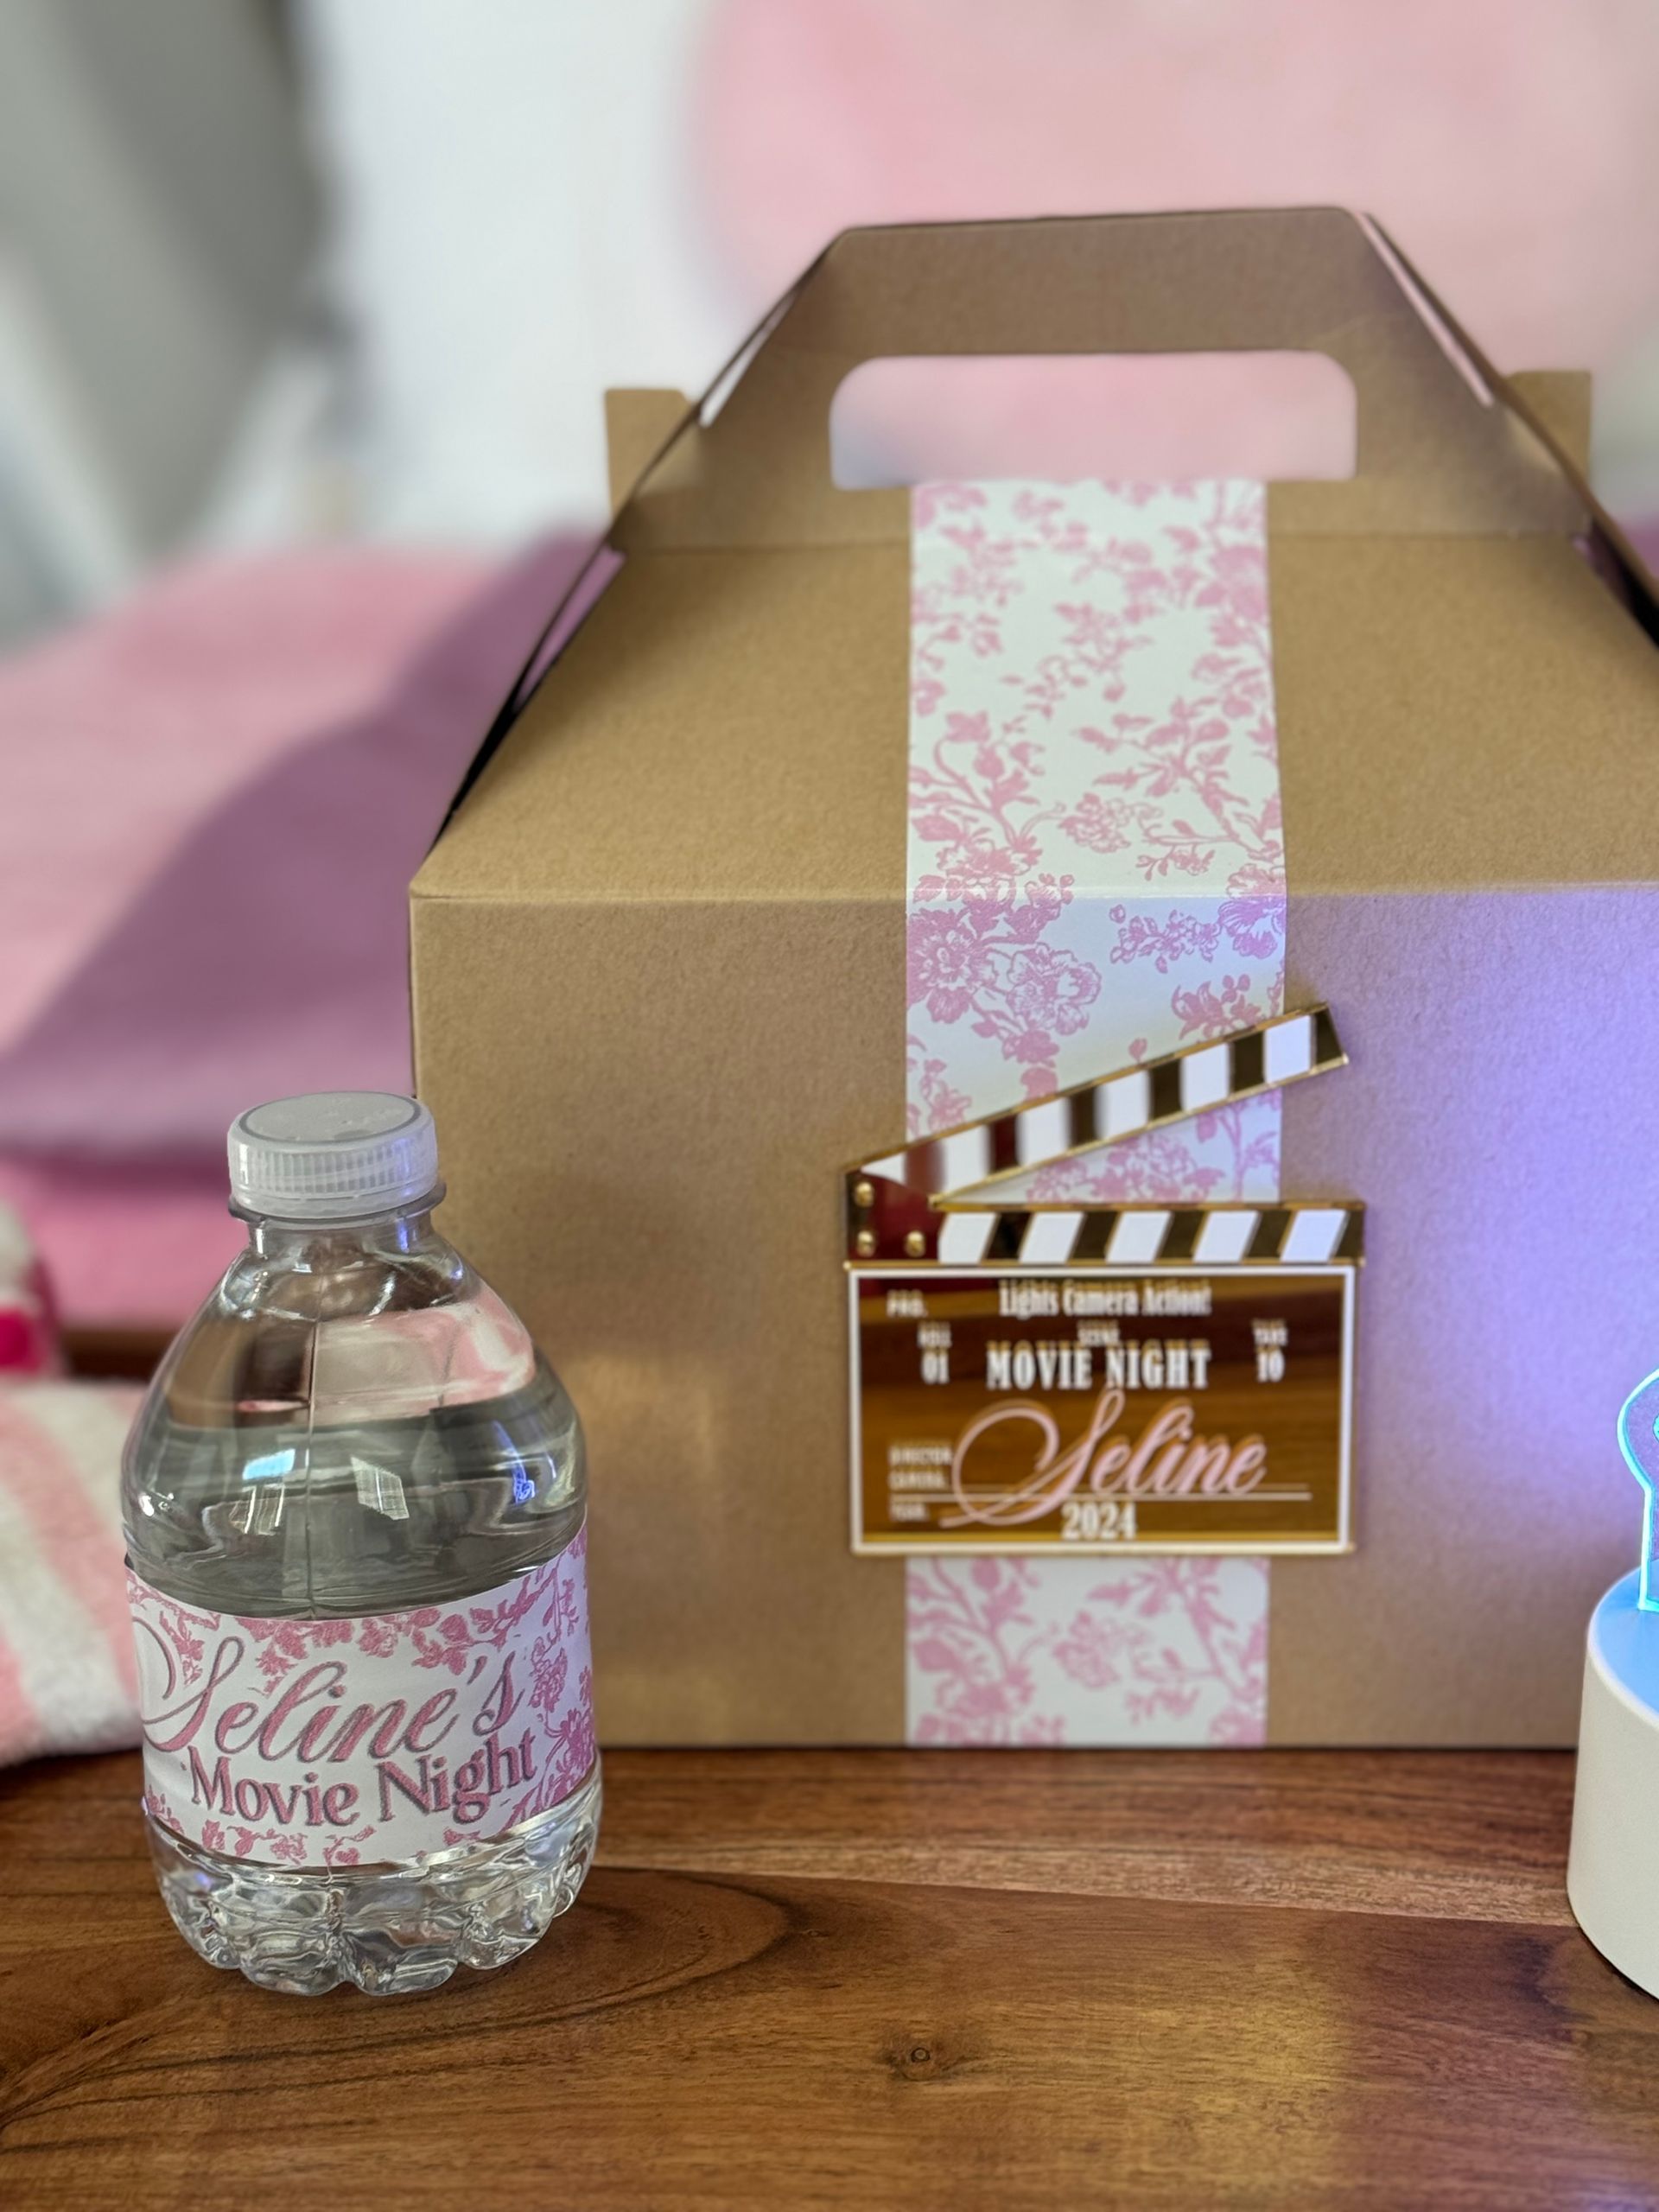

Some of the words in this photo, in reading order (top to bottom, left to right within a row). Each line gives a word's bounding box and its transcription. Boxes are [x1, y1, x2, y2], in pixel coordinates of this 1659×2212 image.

[999, 1285, 1058, 1320] Lights
[1063, 1286, 1139, 1315] Camera
[920, 1351, 950, 1385] 01
[987, 1346, 1092, 1389] MOVIE
[1106, 1348, 1211, 1389] NIGHT
[1257, 1349, 1285, 1383] 10
[939, 1389, 1268, 1529] Seline
[1061, 1502, 1138, 1541] 2024
[132, 1617, 526, 1764] Seline's
[186, 1746, 360, 1827] Movie
[378, 1728, 538, 1824] Night
